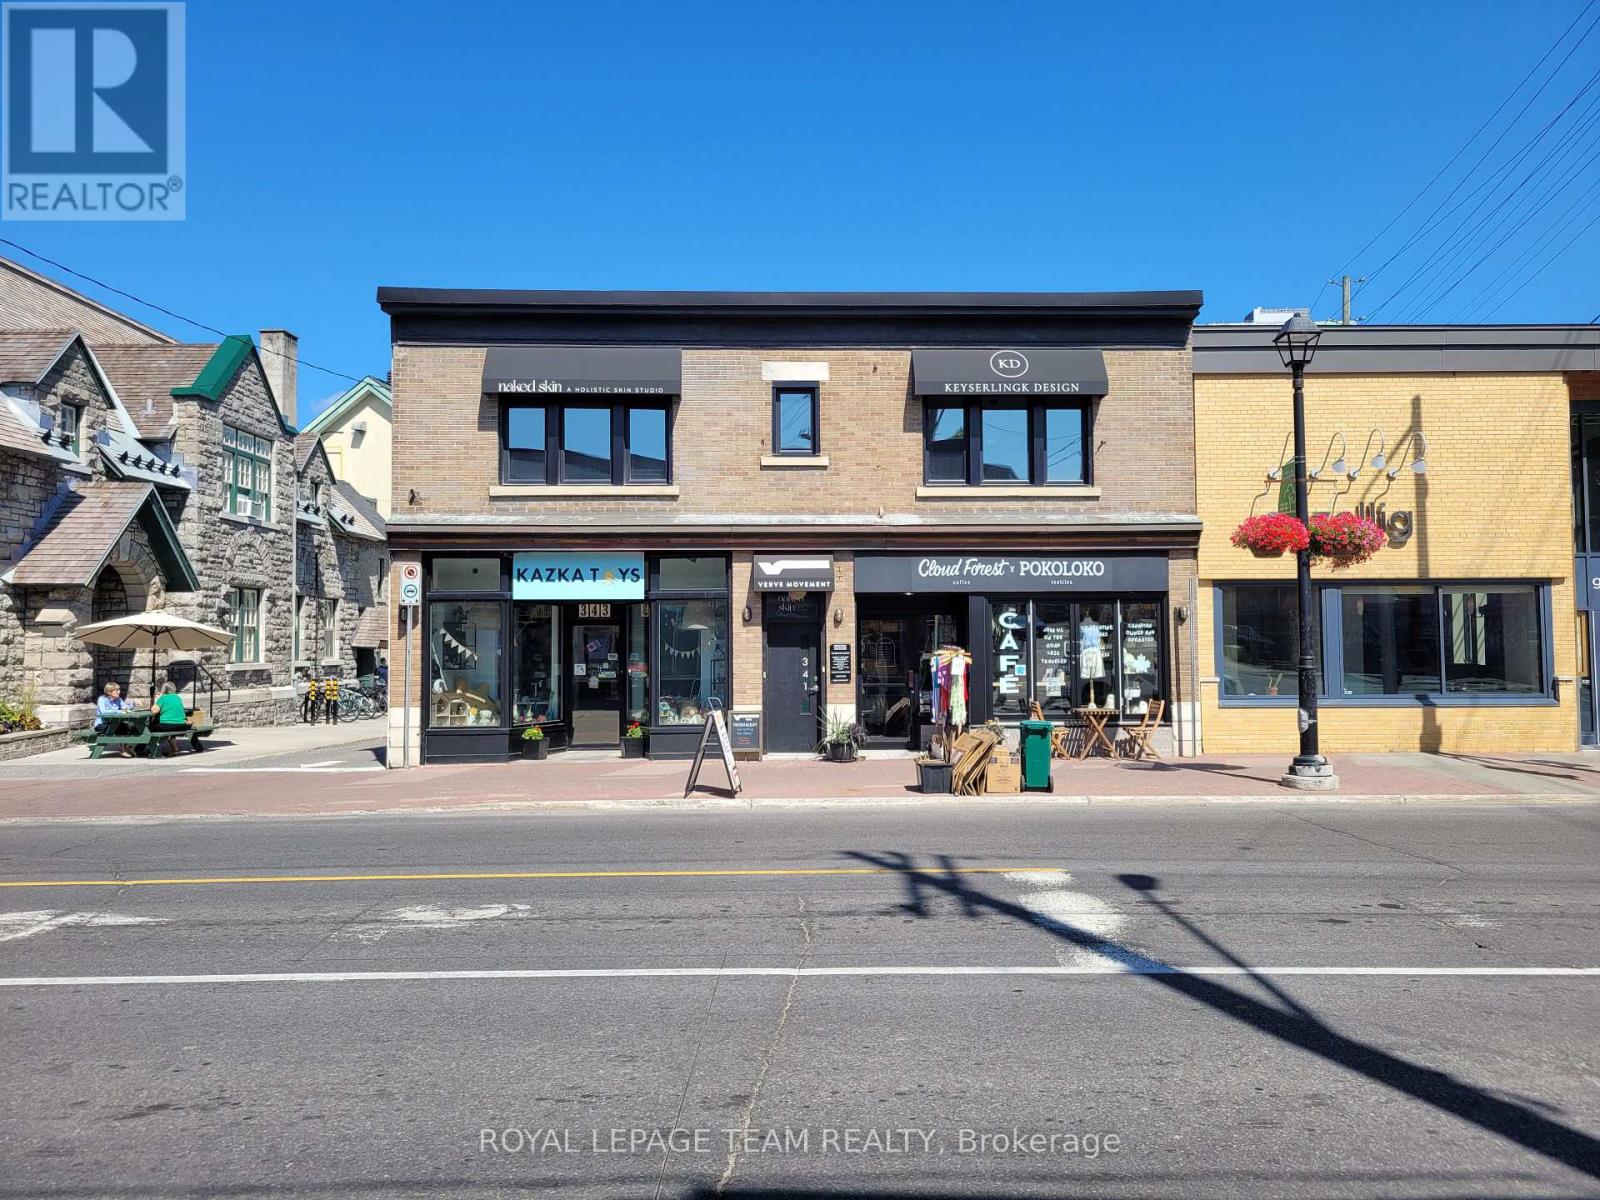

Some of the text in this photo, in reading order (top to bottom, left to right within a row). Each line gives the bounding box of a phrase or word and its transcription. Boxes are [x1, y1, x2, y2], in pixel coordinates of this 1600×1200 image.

[998, 359, 1021, 369] KD
[498, 380, 562, 393] naked skin
[634, 386, 664, 394] STUDIO
[944, 383, 1080, 393] KEYSERLINGK DESIGN
[918, 558, 962, 577] Cloud
[963, 558, 1010, 577] Forest
[1019, 561, 1105, 577] POKOLOKO
[516, 568, 584, 582] KAZKA
[579, 604, 610, 617] 343
